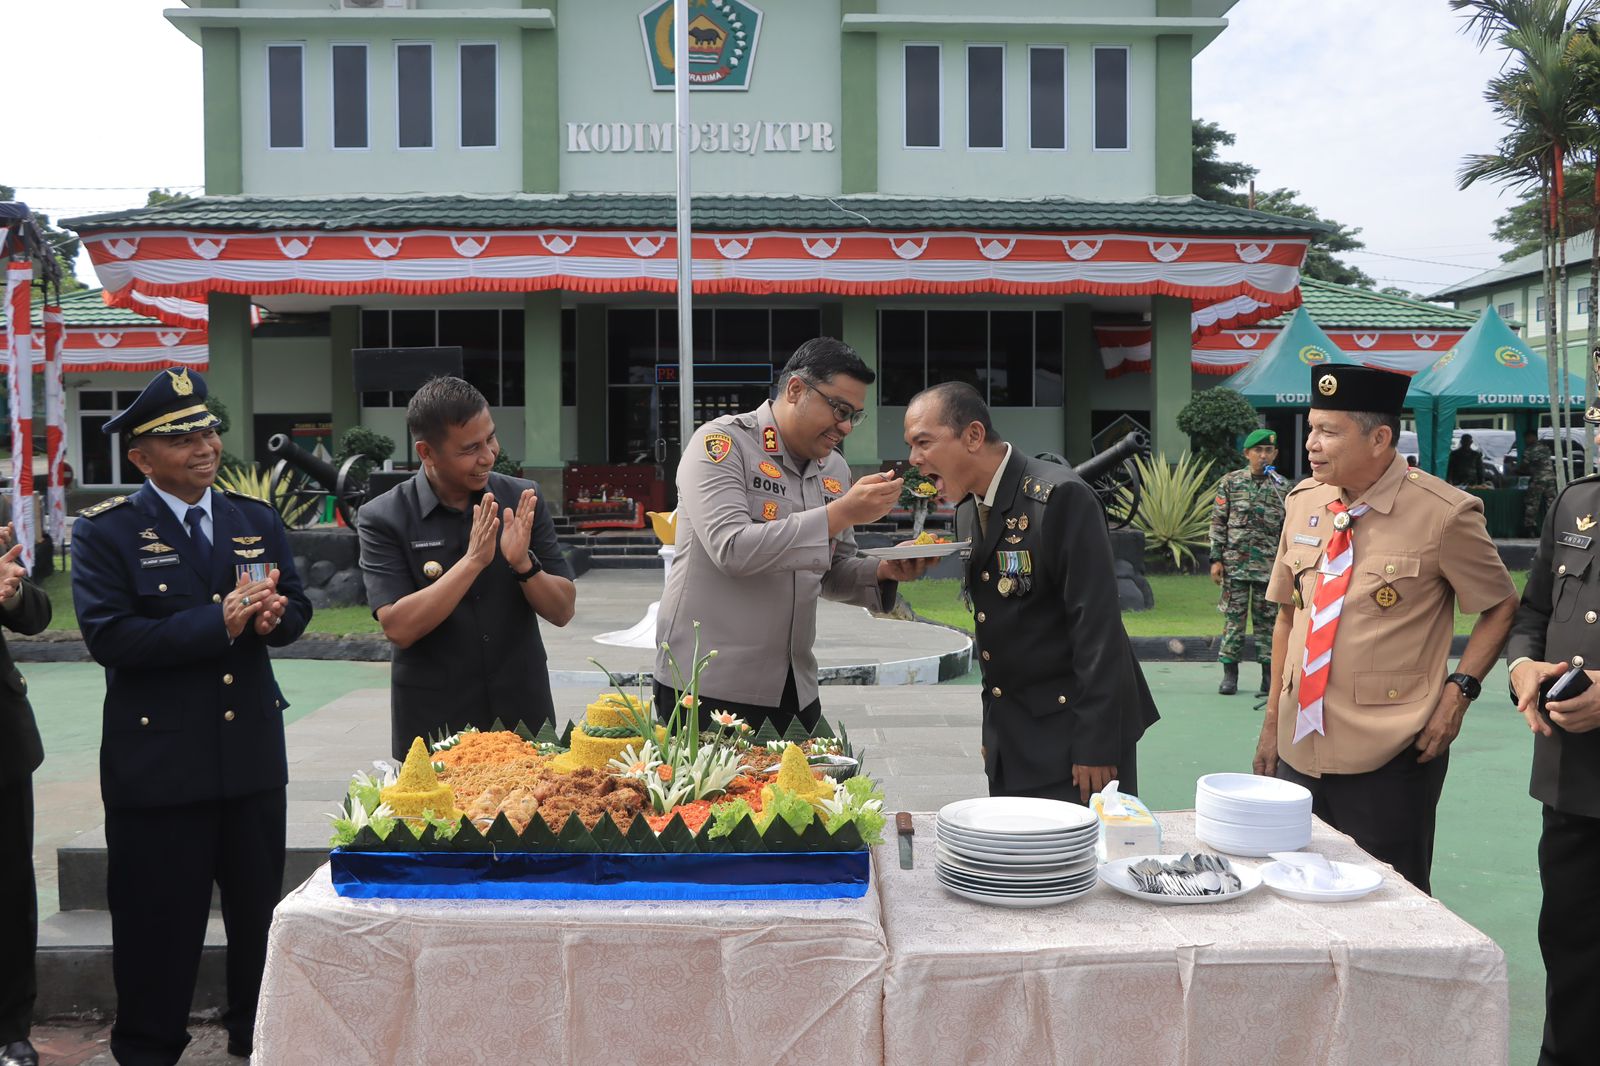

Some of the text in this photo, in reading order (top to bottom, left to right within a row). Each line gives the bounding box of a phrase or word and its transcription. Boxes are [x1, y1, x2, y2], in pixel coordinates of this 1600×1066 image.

[566, 121, 673, 153] KODIM
[1275, 393, 1311, 403] KODI
[1477, 394, 1524, 404] KODIM
[752, 476, 787, 497] BOBY
